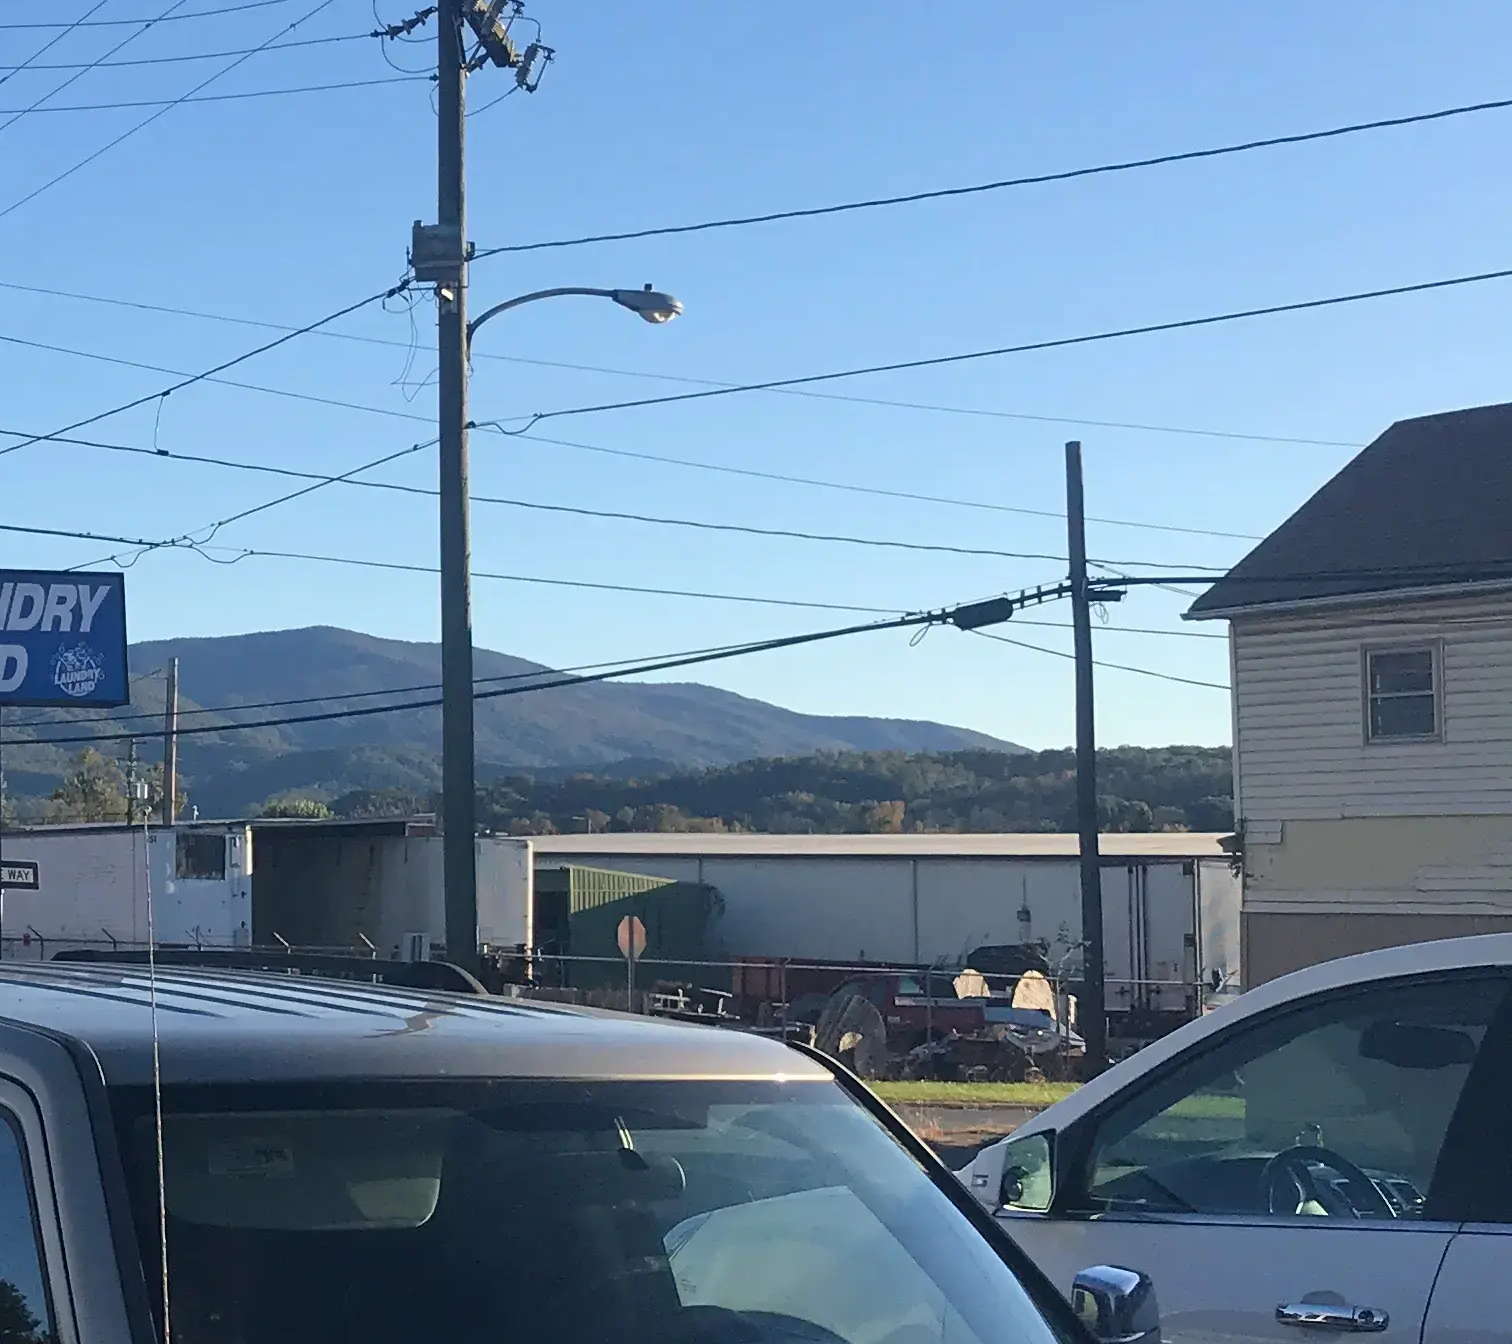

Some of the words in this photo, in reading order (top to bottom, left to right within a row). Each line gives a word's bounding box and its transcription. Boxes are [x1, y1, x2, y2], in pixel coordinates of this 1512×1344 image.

[54, 668, 101, 685] LAUNDRY
[68, 681, 96, 694] LAND
[7, 869, 30, 881] WAY
